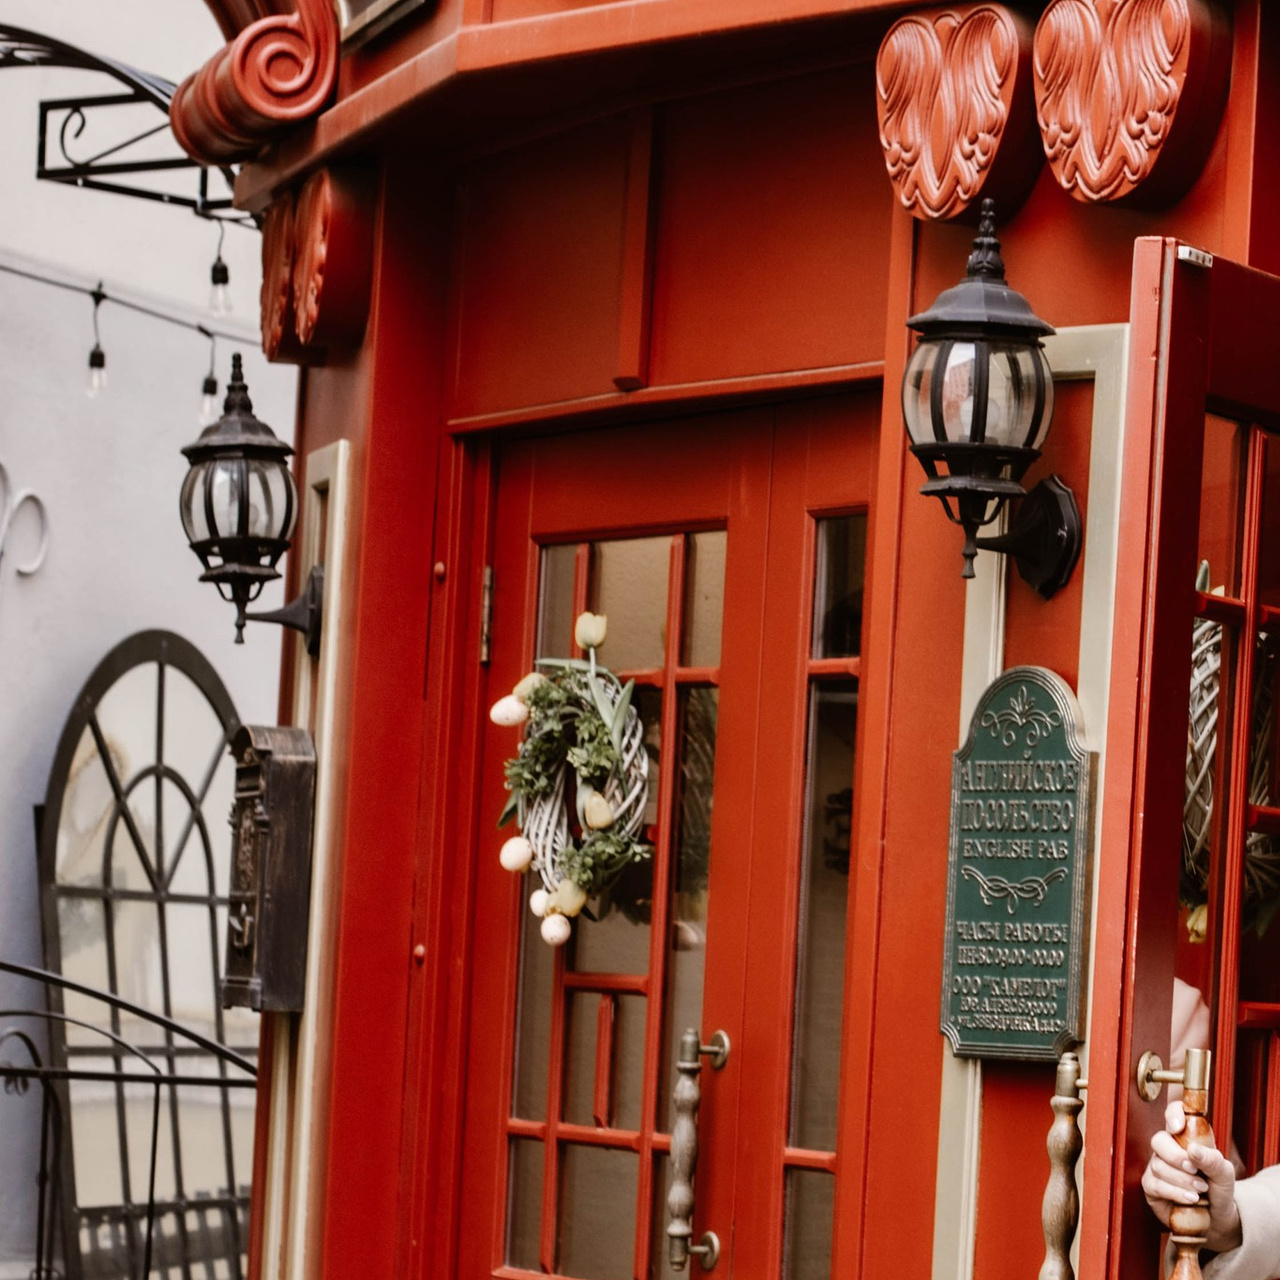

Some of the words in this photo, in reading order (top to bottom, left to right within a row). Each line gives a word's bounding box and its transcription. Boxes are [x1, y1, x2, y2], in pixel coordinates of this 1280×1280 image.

[961, 750, 1078, 791] АНГЛИЙСКОЕ
[961, 799, 1075, 831] ПОСОЛЬСТВО
[963, 839, 1033, 859] ENGLISH
[1037, 839, 1069, 859] PAB
[956, 921, 1000, 940] ЧАСЫ
[1004, 922, 1068, 942] РАБОТЫ
[952, 975, 982, 994] ООО
